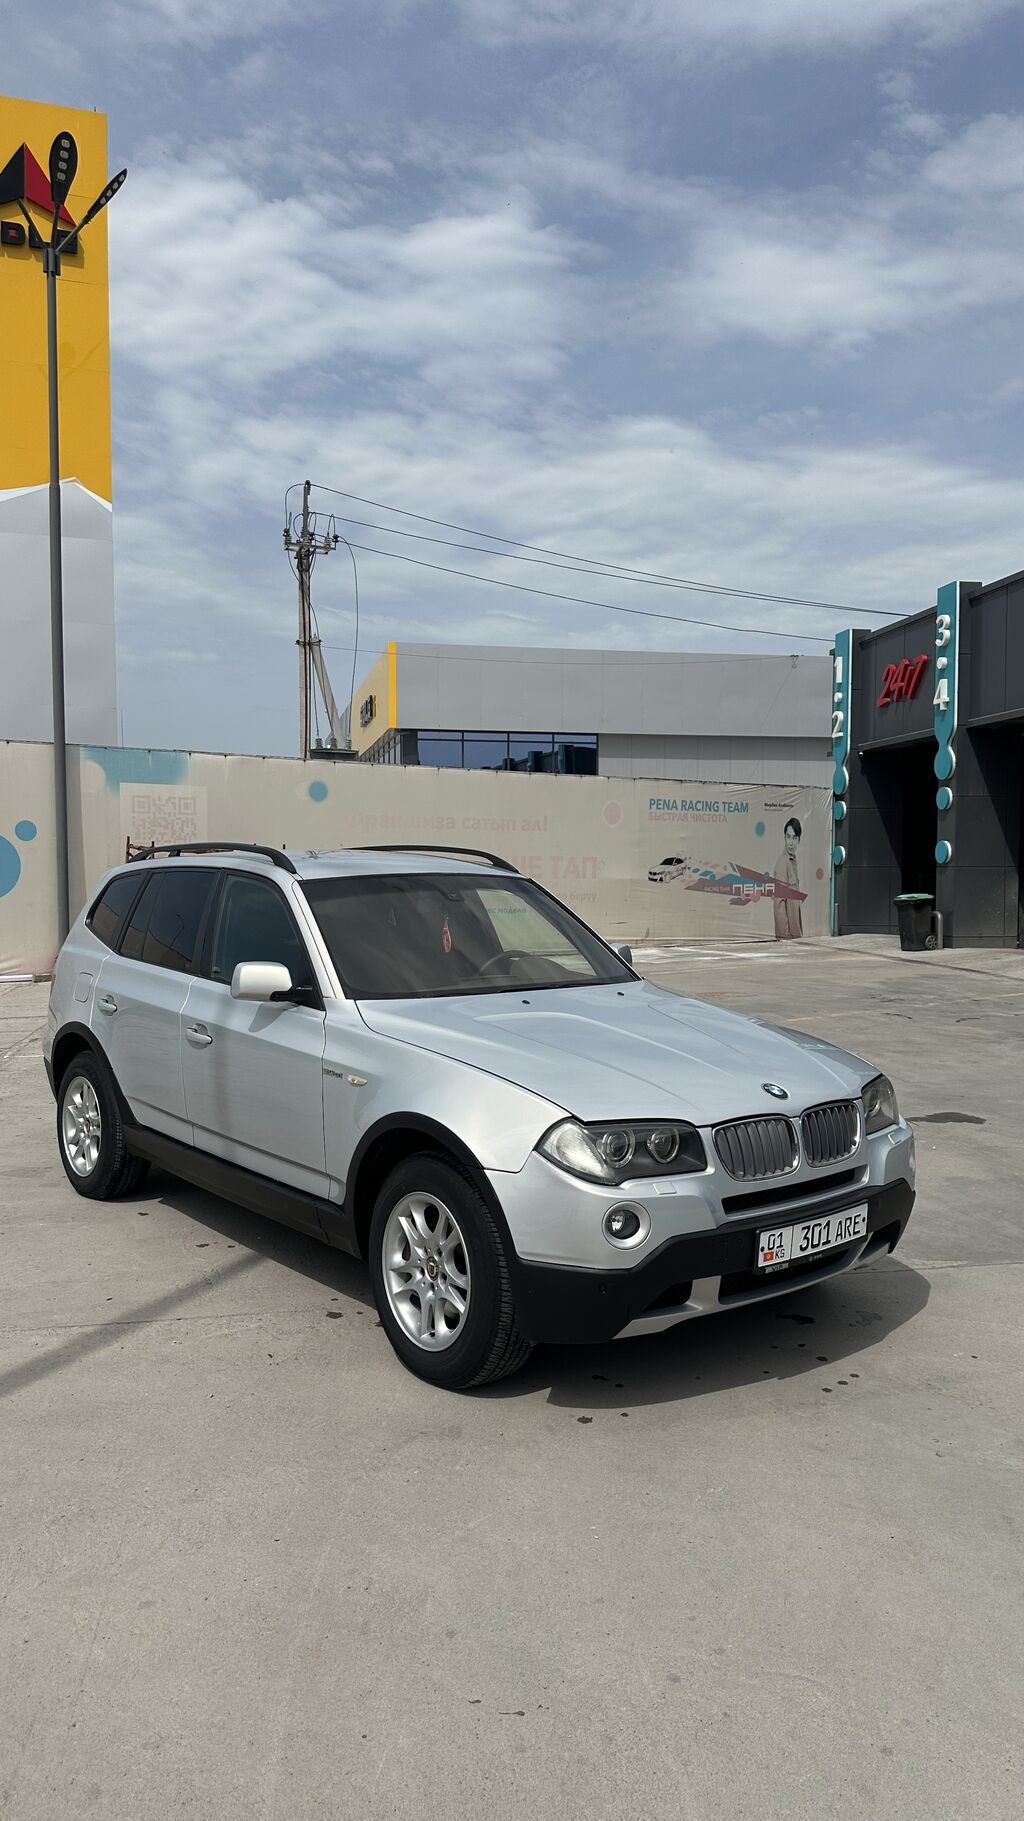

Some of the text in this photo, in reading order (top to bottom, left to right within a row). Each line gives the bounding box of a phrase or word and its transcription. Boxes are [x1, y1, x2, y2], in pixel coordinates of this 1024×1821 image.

[935, 614, 951, 647] 3
[933, 678, 950, 711] 4
[831, 710, 844, 739] 2
[649, 798, 677, 811] PENA
[681, 799, 720, 812] RACING
[721, 802, 749, 813] TEAM
[649, 811, 728, 823] БЫСТРАЯ ЧИСТОТА
[767, 1231, 784, 1250] 01
[799, 1214, 862, 1252] 301 ARE
